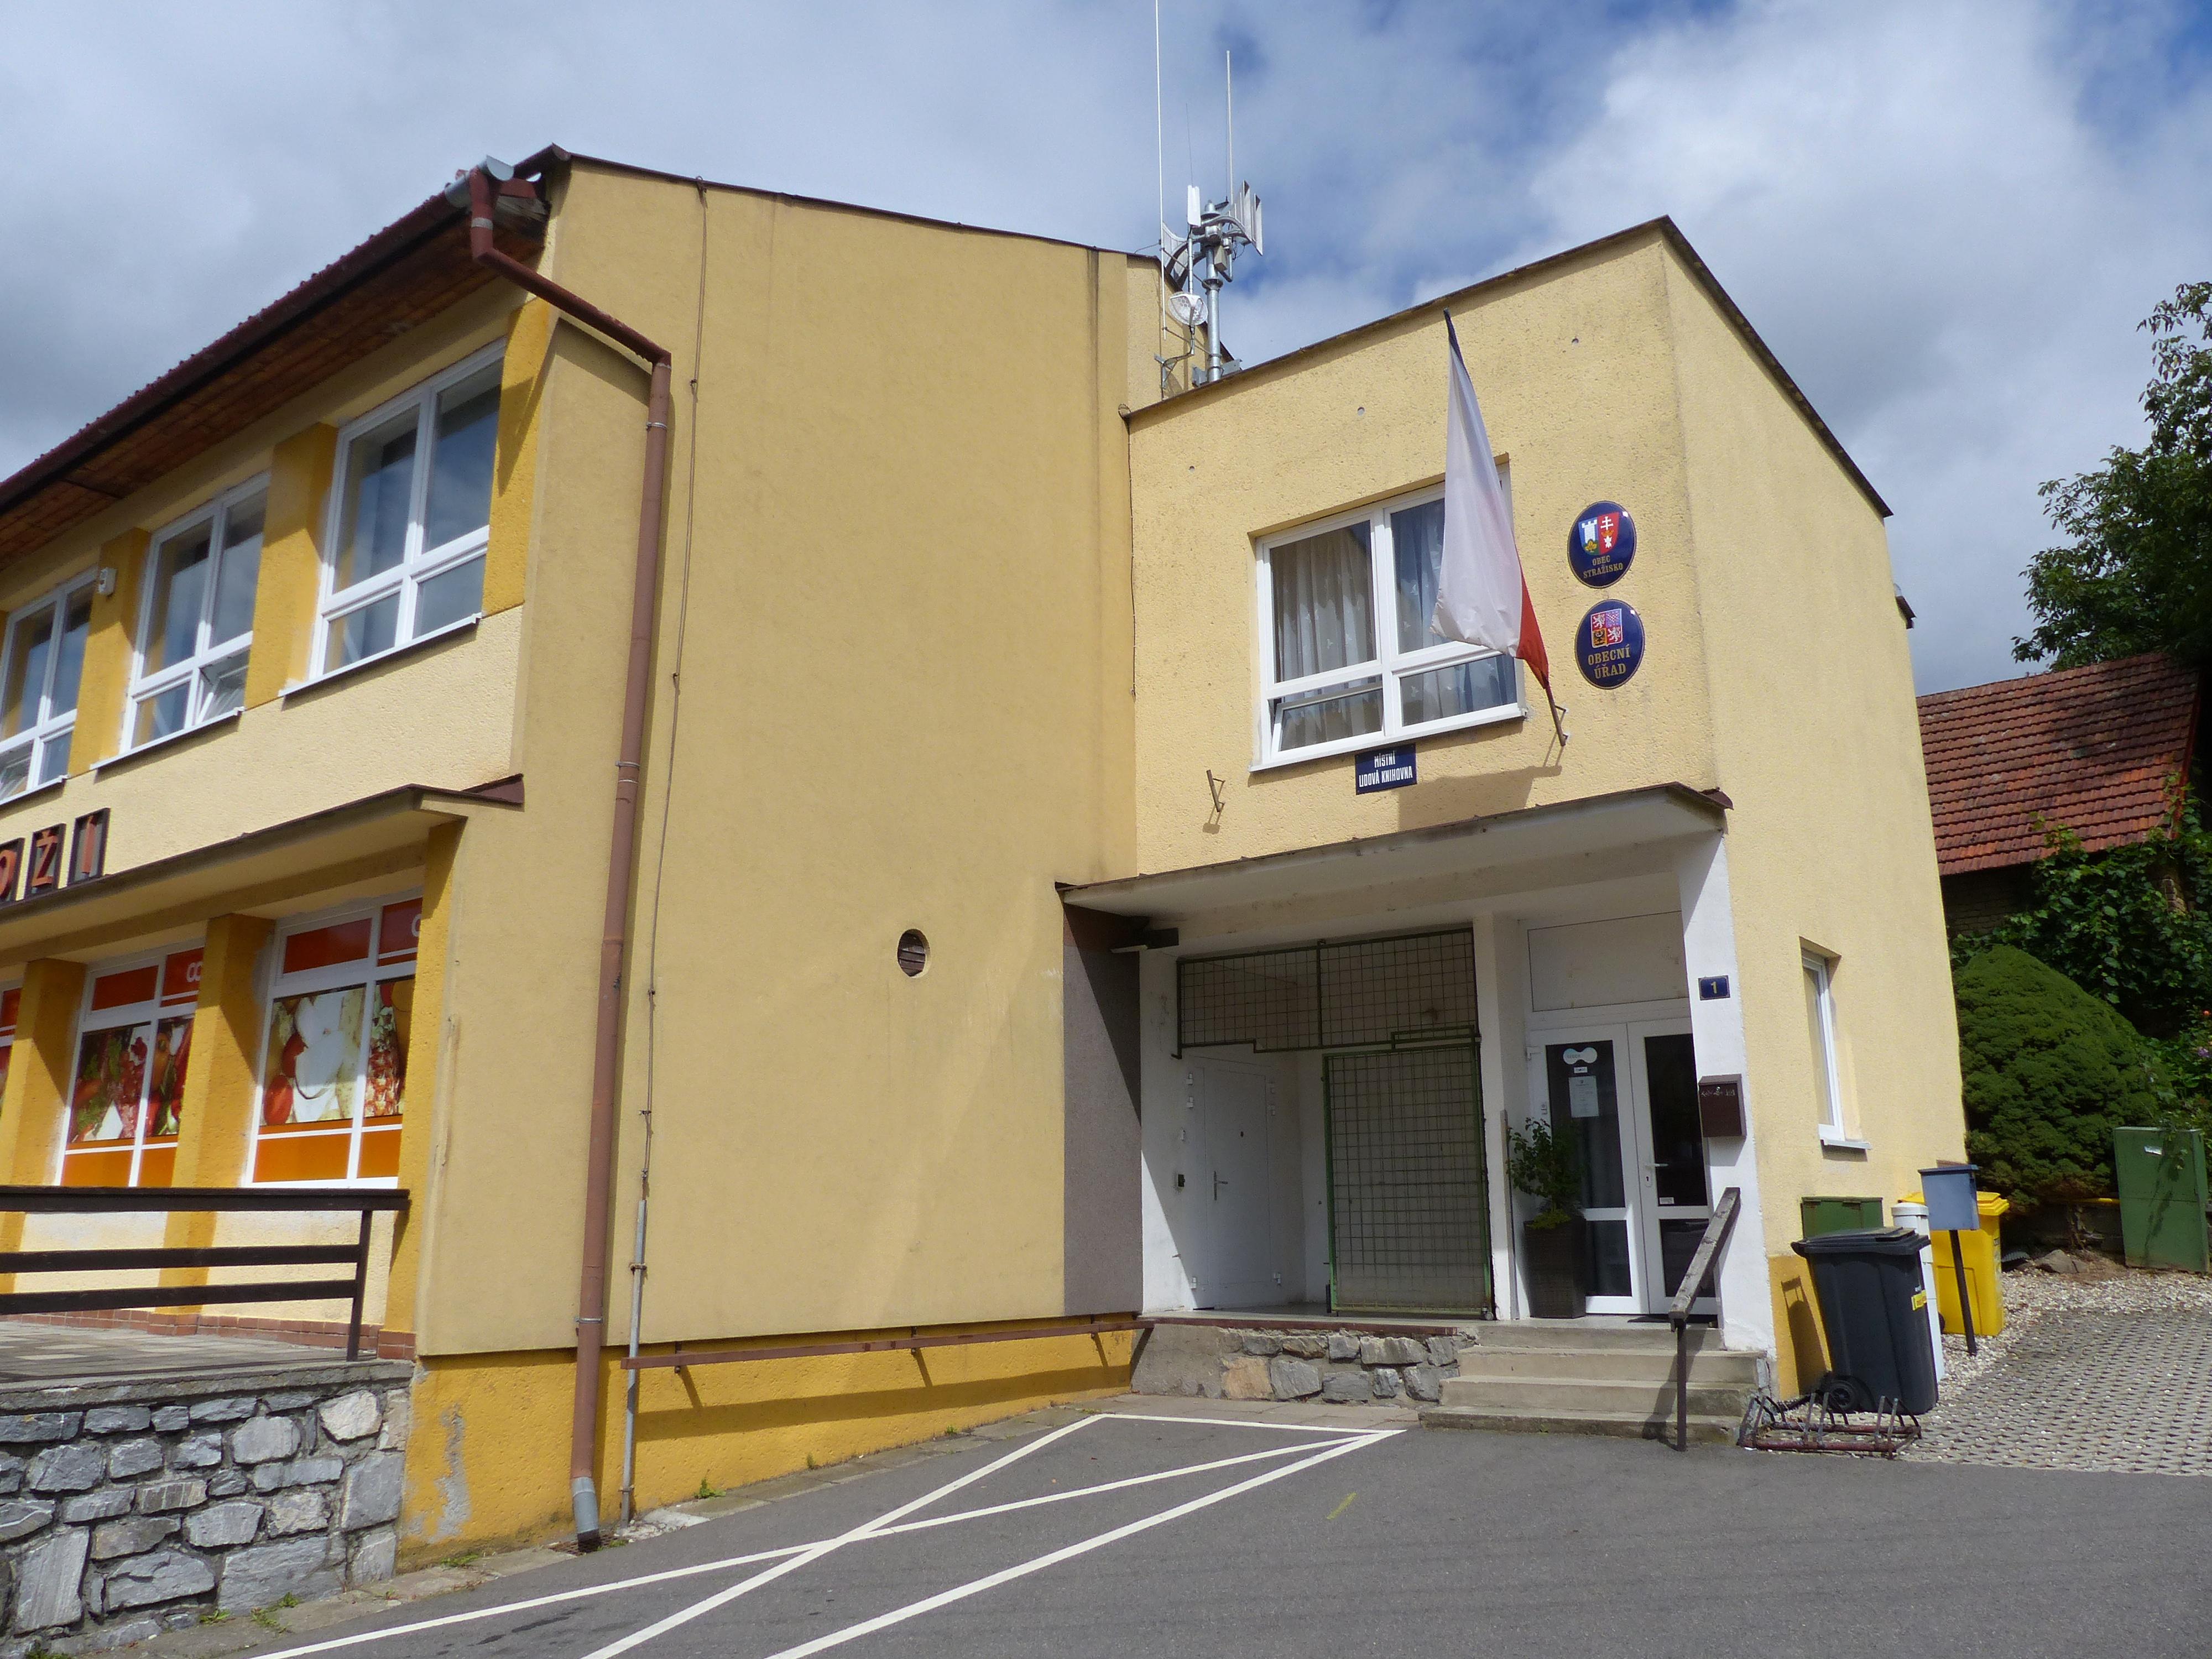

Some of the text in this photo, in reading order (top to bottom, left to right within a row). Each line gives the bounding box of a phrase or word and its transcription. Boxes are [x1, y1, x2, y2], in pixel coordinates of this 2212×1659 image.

[1592, 555, 1610, 566] OBEC
[1583, 562, 1623, 578] STRAŽISKO
[1588, 644, 1631, 665] OBECNÍ
[1594, 663, 1626, 679] ÚŘAD
[1374, 750, 1396, 768] MÍSTNÍ
[1359, 766, 1413, 787] LIDOVÁ KNIHOVNA
[1710, 981, 1717, 994] 1
